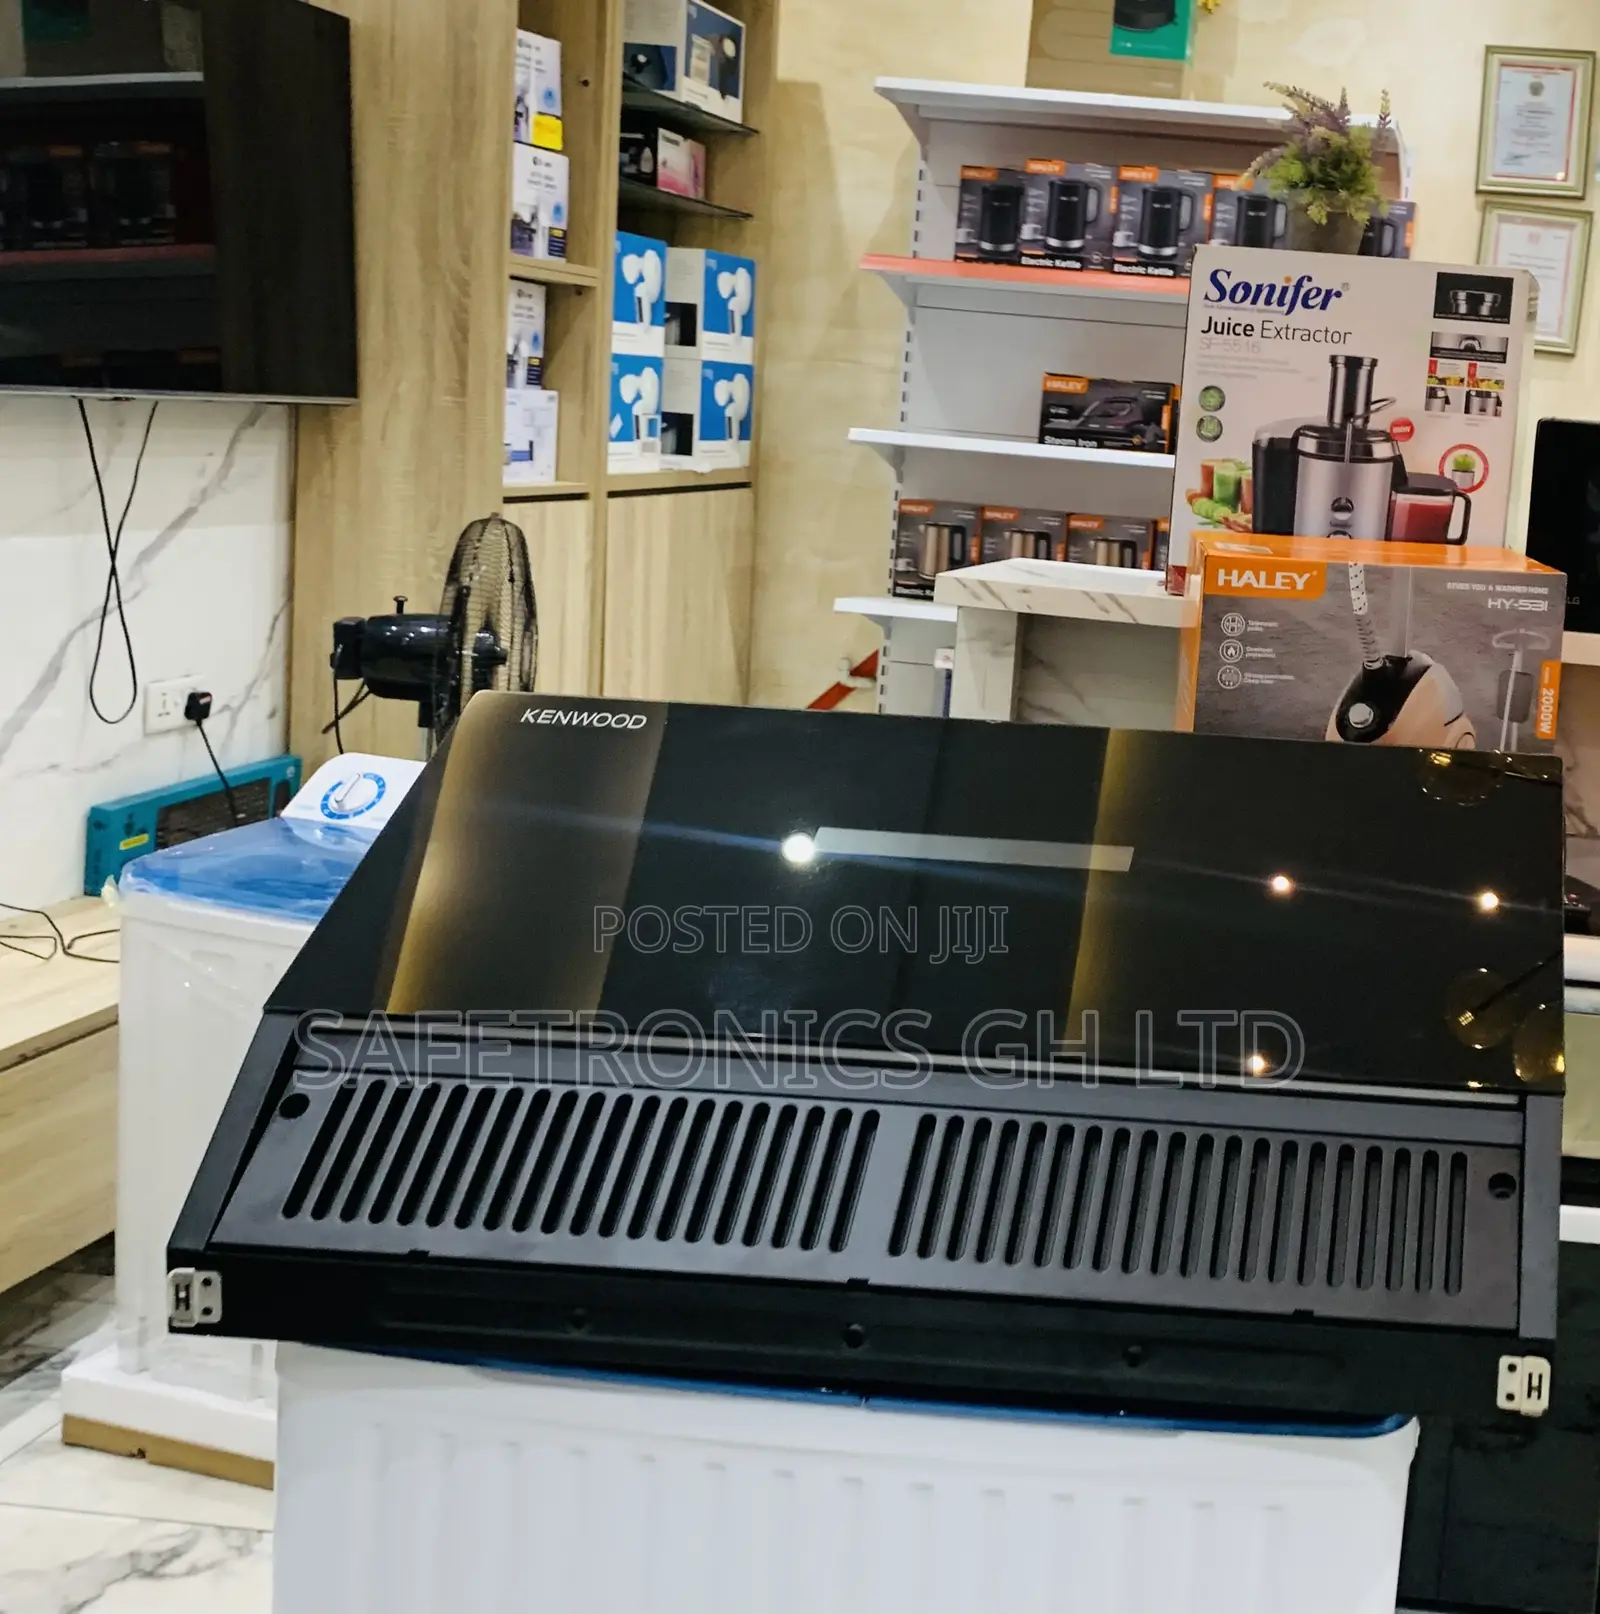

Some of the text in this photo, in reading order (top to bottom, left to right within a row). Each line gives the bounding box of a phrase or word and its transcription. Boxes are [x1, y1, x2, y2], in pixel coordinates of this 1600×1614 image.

[1204, 268, 1343, 316] Sonifer
[1201, 316, 1353, 345] Juice Extractor
[1044, 435, 1077, 447] Steam
[1217, 568, 1311, 591] HALEY
[520, 708, 648, 729] KENWOOD
[1540, 687, 1555, 735] 2000W
